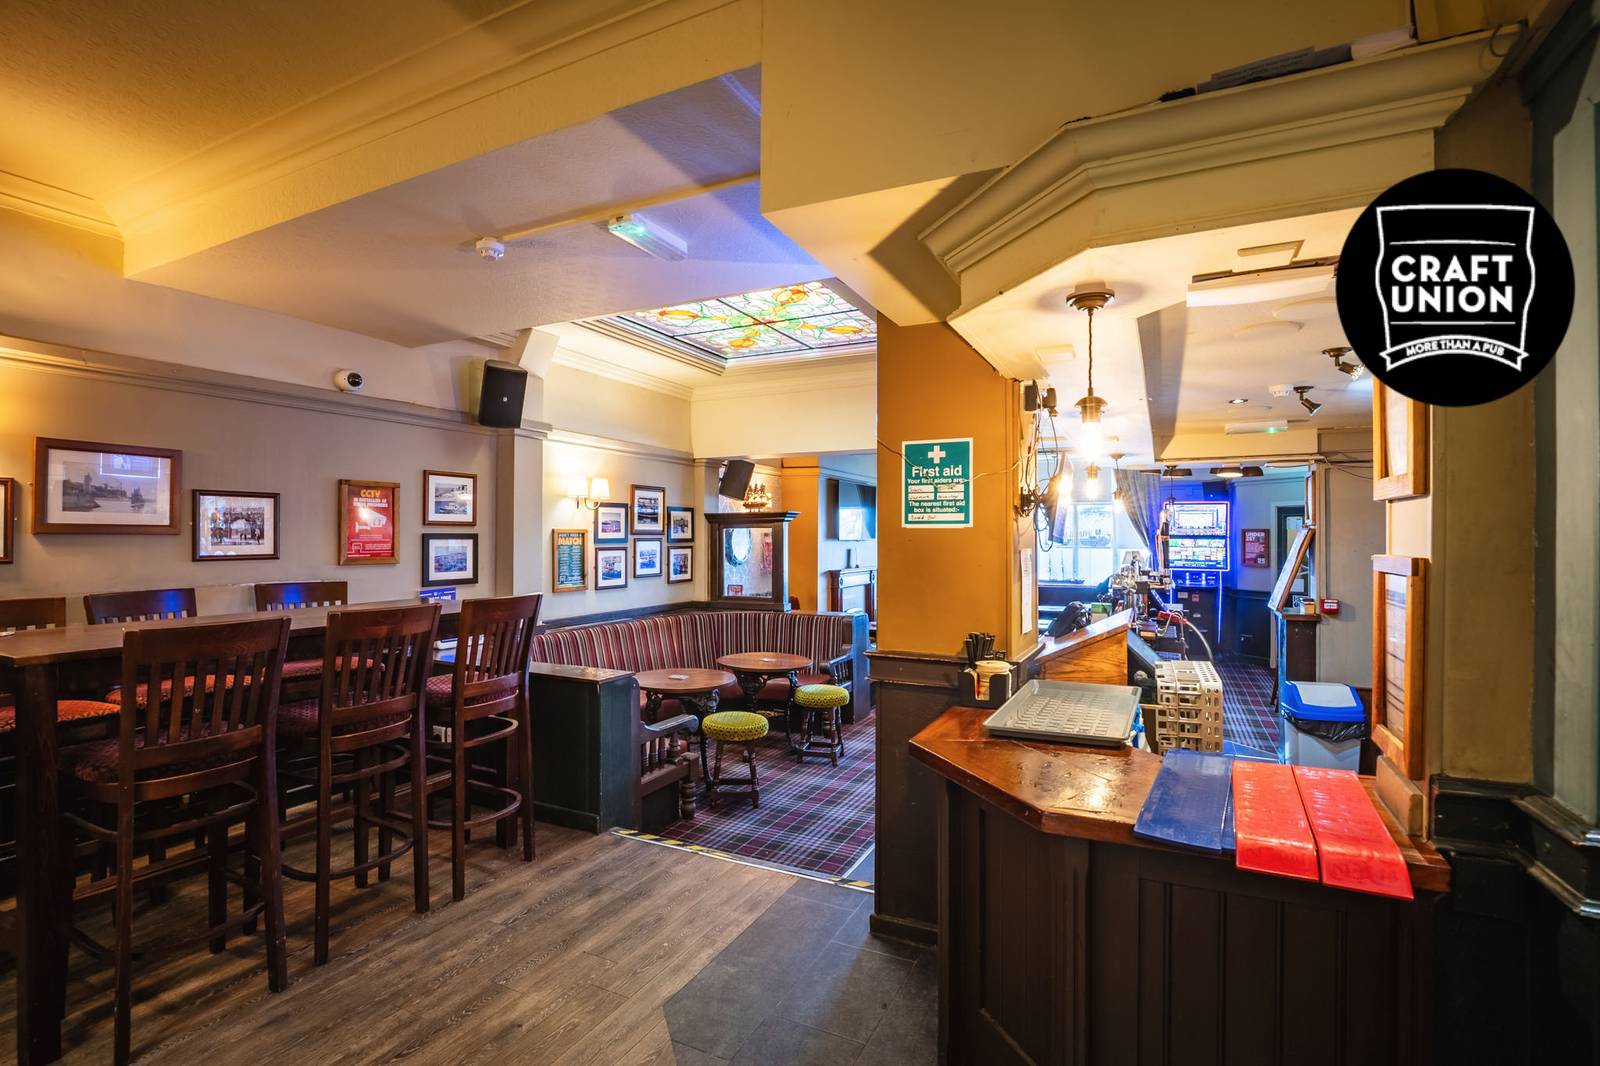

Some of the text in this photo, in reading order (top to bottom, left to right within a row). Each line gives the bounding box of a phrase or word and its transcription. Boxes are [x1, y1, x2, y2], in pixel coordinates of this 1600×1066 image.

[912, 465, 962, 477] First aid
[360, 489, 381, 498] CCTV
